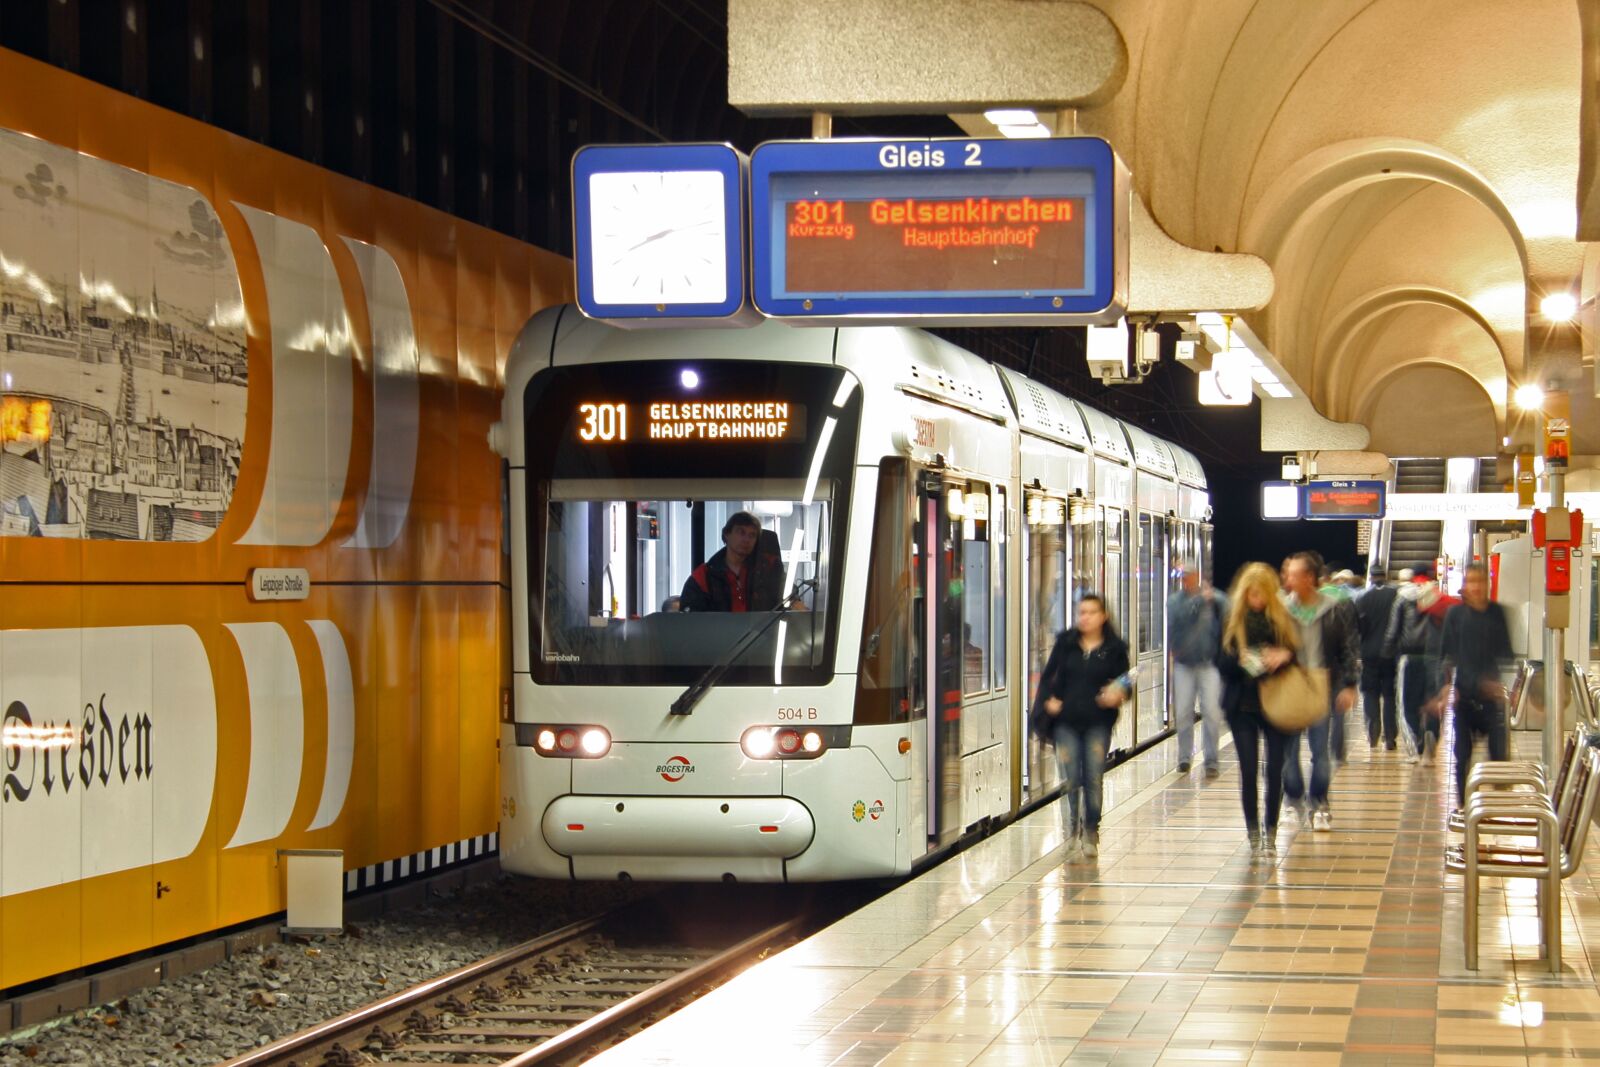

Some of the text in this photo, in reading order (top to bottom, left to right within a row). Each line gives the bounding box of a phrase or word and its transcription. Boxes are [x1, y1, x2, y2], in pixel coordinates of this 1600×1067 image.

[878, 143, 982, 168] Gleis 2
[794, 197, 1072, 224] 301 Gelsenkirchen
[789, 224, 854, 240] Kurzzug
[904, 226, 1039, 249] Hauptbahnhof
[580, 403, 788, 440] 301 GELSENKIRCHEN
[650, 422, 788, 438] HAUPTBAHNHOF
[260, 575, 302, 595] Leipziger Straße
[778, 707, 817, 720] 504 B
[3, 693, 153, 803] Dresden
[656, 765, 695, 773] BOGESTRA
